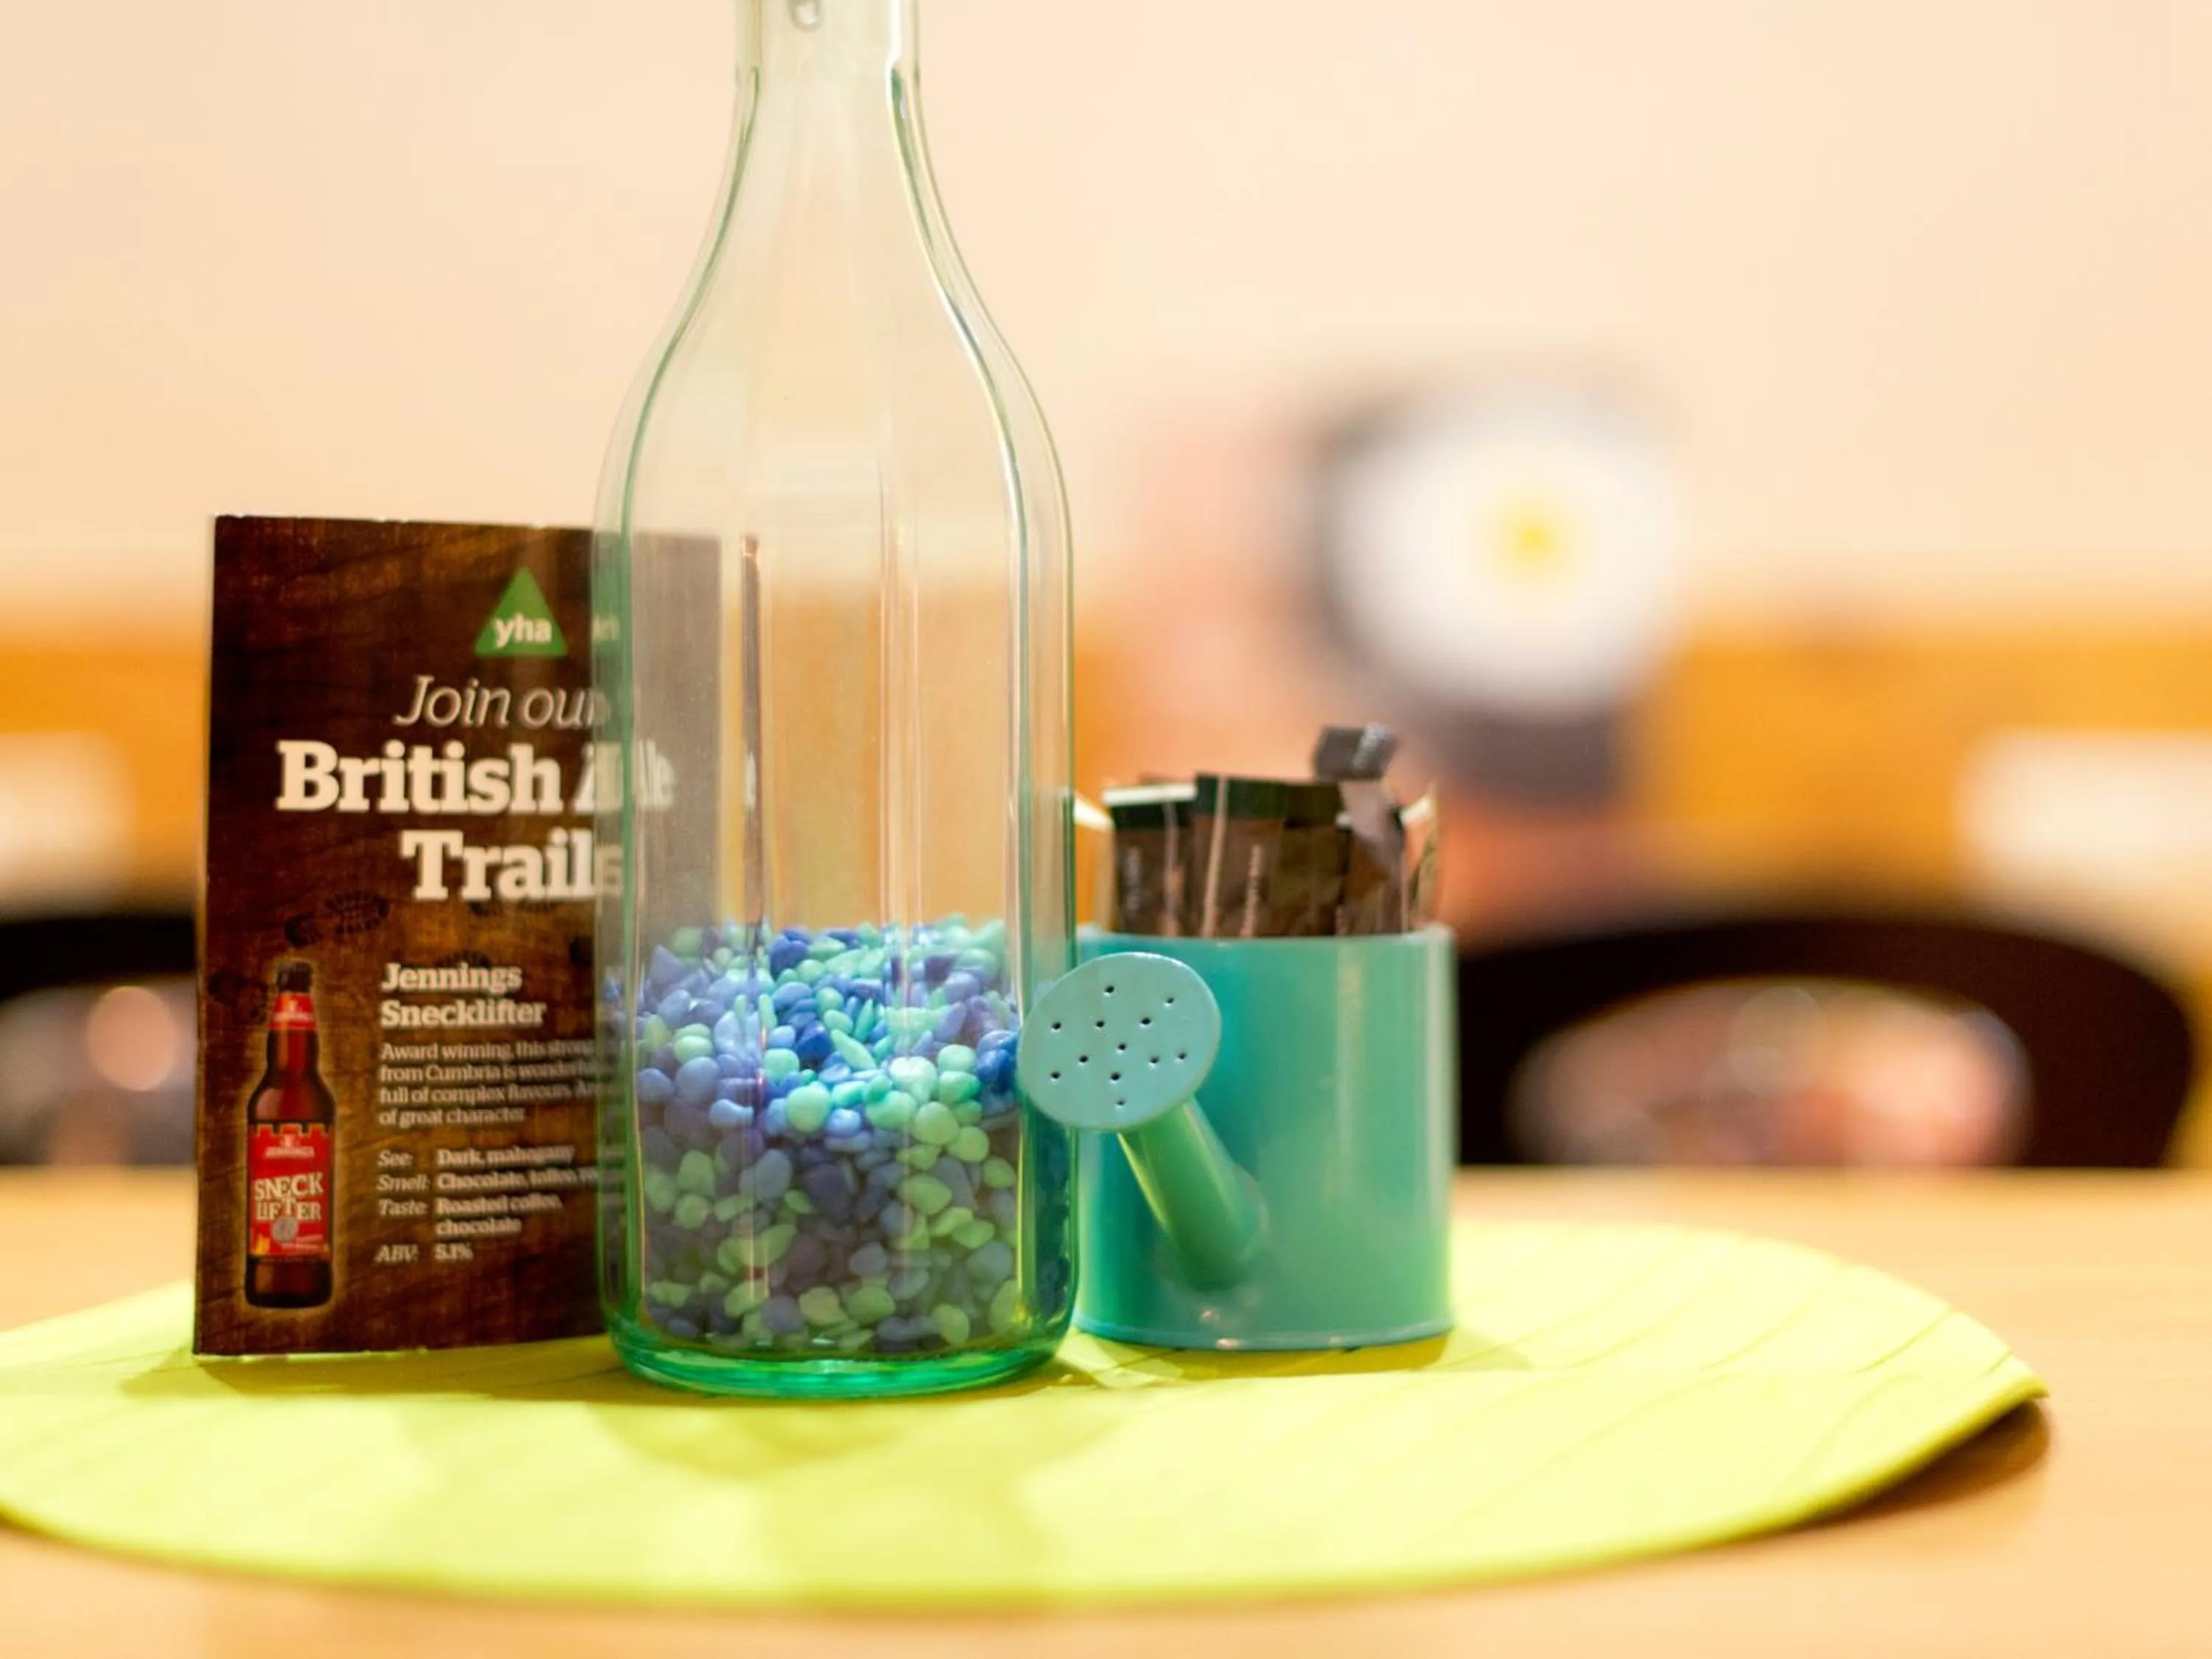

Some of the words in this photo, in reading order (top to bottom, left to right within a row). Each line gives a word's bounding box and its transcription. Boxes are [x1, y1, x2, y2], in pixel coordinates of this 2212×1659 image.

[494, 612, 552, 648] yha
[394, 675, 510, 727] Join
[276, 739, 565, 814] British
[381, 962, 523, 994] Jennings
[380, 1000, 547, 1027] Snecklifter
[380, 1042, 439, 1060] Award
[516, 1040, 546, 1057] this
[380, 1065, 423, 1082] from
[425, 1064, 501, 1082] Cumbria
[380, 1087, 408, 1105] full
[410, 1086, 429, 1102] of
[379, 1109, 397, 1125] of
[399, 1110, 442, 1129] great
[255, 1171, 324, 1202] SNECK
[256, 1195, 322, 1221] LIFTER
